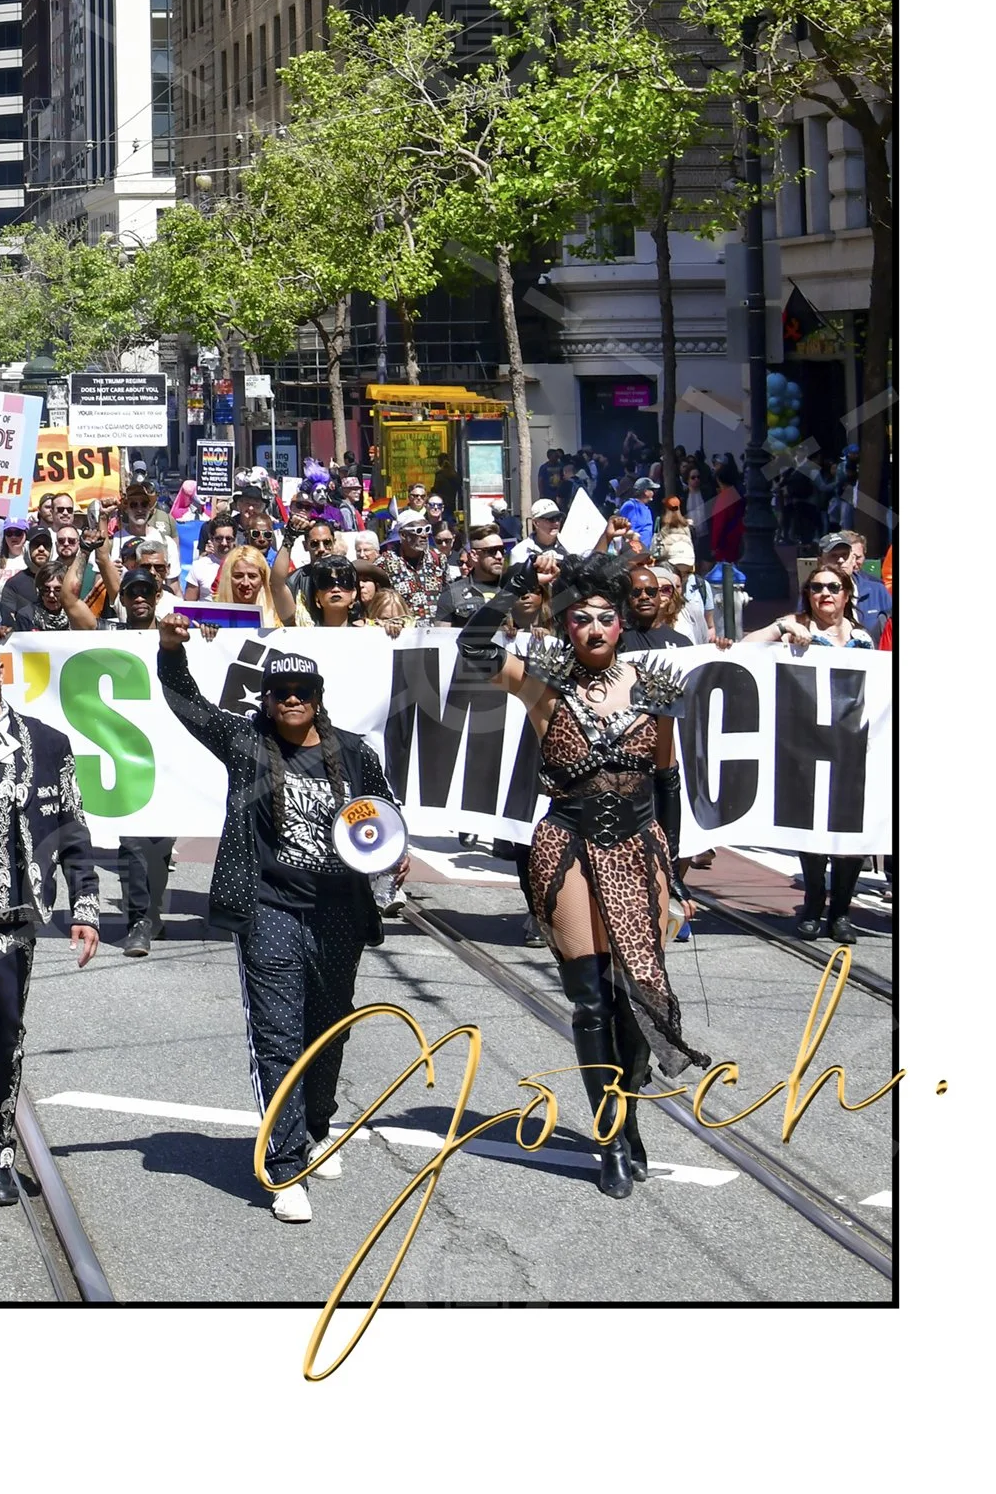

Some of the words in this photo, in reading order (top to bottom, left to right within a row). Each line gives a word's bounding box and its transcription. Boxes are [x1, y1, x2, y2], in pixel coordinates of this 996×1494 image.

[2, 415, 12, 424] OF
[32, 446, 114, 483] ESIST
[202, 447, 229, 466] NO!
[270, 656, 315, 674] ENOUGH!
[384, 647, 868, 833] MCH
[347, 803, 370, 821] OUT
[348, 808, 376, 824] OW
